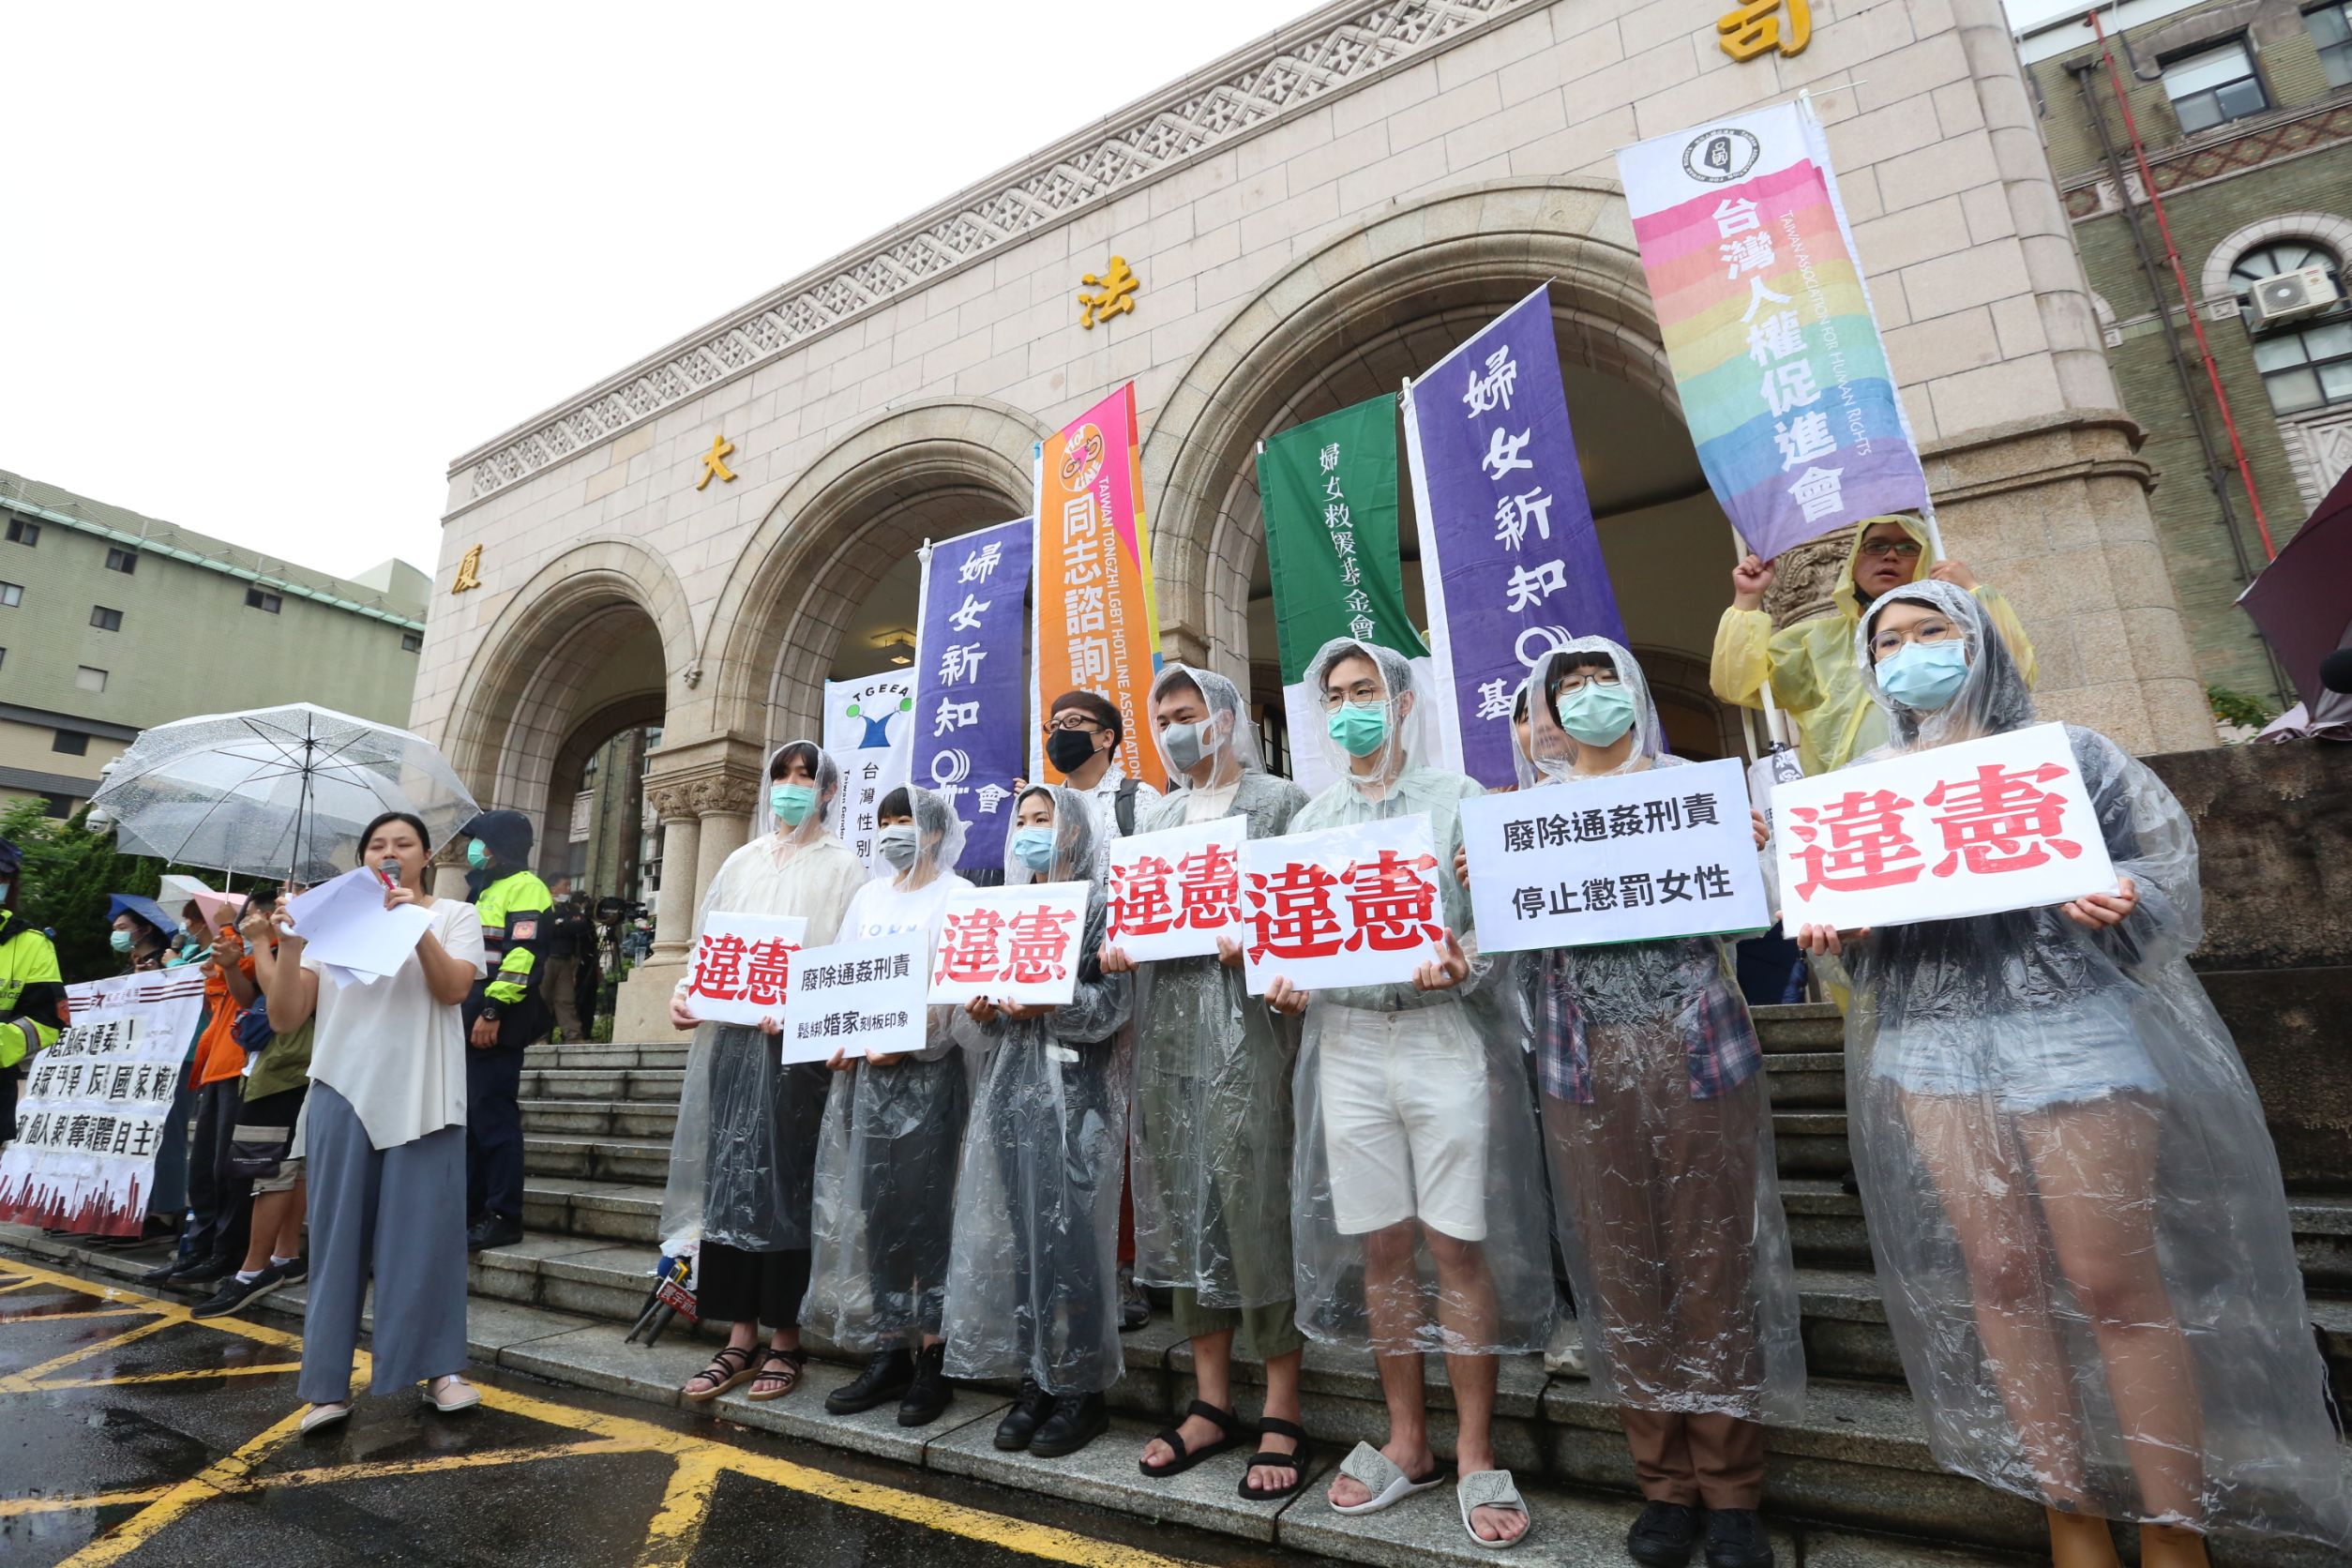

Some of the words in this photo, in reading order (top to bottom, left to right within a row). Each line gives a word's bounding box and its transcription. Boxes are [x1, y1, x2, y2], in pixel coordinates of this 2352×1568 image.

[1717, 0, 1811, 63] 司
[1078, 256, 1140, 329] 法
[1711, 197, 1845, 523] 台灣人權促進會
[1780, 209, 1803, 252] TAIWAN
[1798, 253, 1831, 324] ASSOCIATION
[1821, 322, 1838, 351] FOR
[1830, 351, 1855, 407] HUMAN
[1847, 407, 1872, 457] RIGHTS
[695, 435, 738, 491] 大
[1464, 344, 1567, 612] 婦女新知
[1098, 475, 1113, 527] TAIWAN
[1102, 530, 1119, 588] TONGZHI
[1319, 442, 1376, 641] 婦女救援基金會
[934, 541, 1002, 737] 婦女新知
[1107, 591, 1123, 627] LGBT
[852, 684, 910, 702] TGEEA
[1111, 628, 1130, 687] HOTLINE
[1119, 689, 1141, 780] ASSOCIATION
[856, 761, 879, 869] 台灣性別
[1503, 792, 1718, 852] 廢除通姦刑責
[1787, 763, 2083, 902] 違憲
[1107, 844, 1242, 942] 違憲
[1244, 850, 1443, 966] 違憲
[1512, 864, 1734, 920] 停止懲罰女性
[688, 933, 802, 1005] 違憲
[801, 954, 911, 991] 廢除通姦刑責
[935, 906, 1078, 985] 違憲
[797, 1011, 908, 1039] 鬆綁婚家刻板印象
